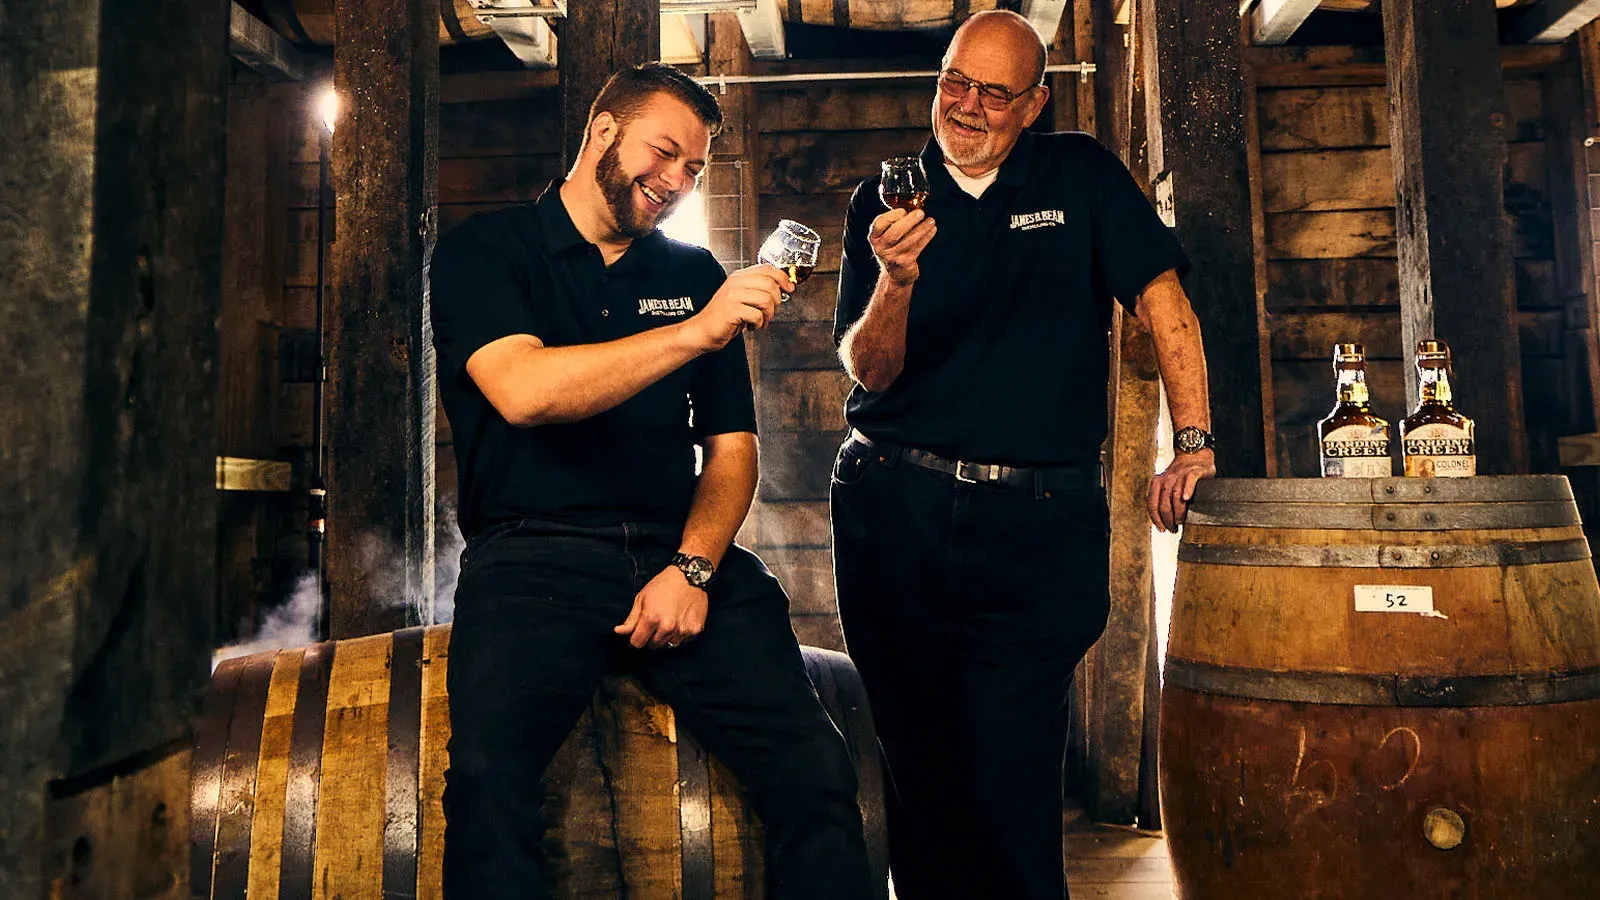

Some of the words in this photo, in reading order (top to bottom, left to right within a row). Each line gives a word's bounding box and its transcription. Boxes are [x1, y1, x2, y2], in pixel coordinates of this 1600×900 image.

[1010, 214, 1034, 229] JAMES
[1041, 210, 1065, 224] BEAM
[639, 299, 662, 314] JAMES
[668, 296, 694, 311] BEAM
[1325, 447, 1387, 456] CREEK
[1407, 445, 1469, 455] CREEK
[1436, 460, 1470, 469] COLONEL
[1386, 593, 1408, 608] 52
